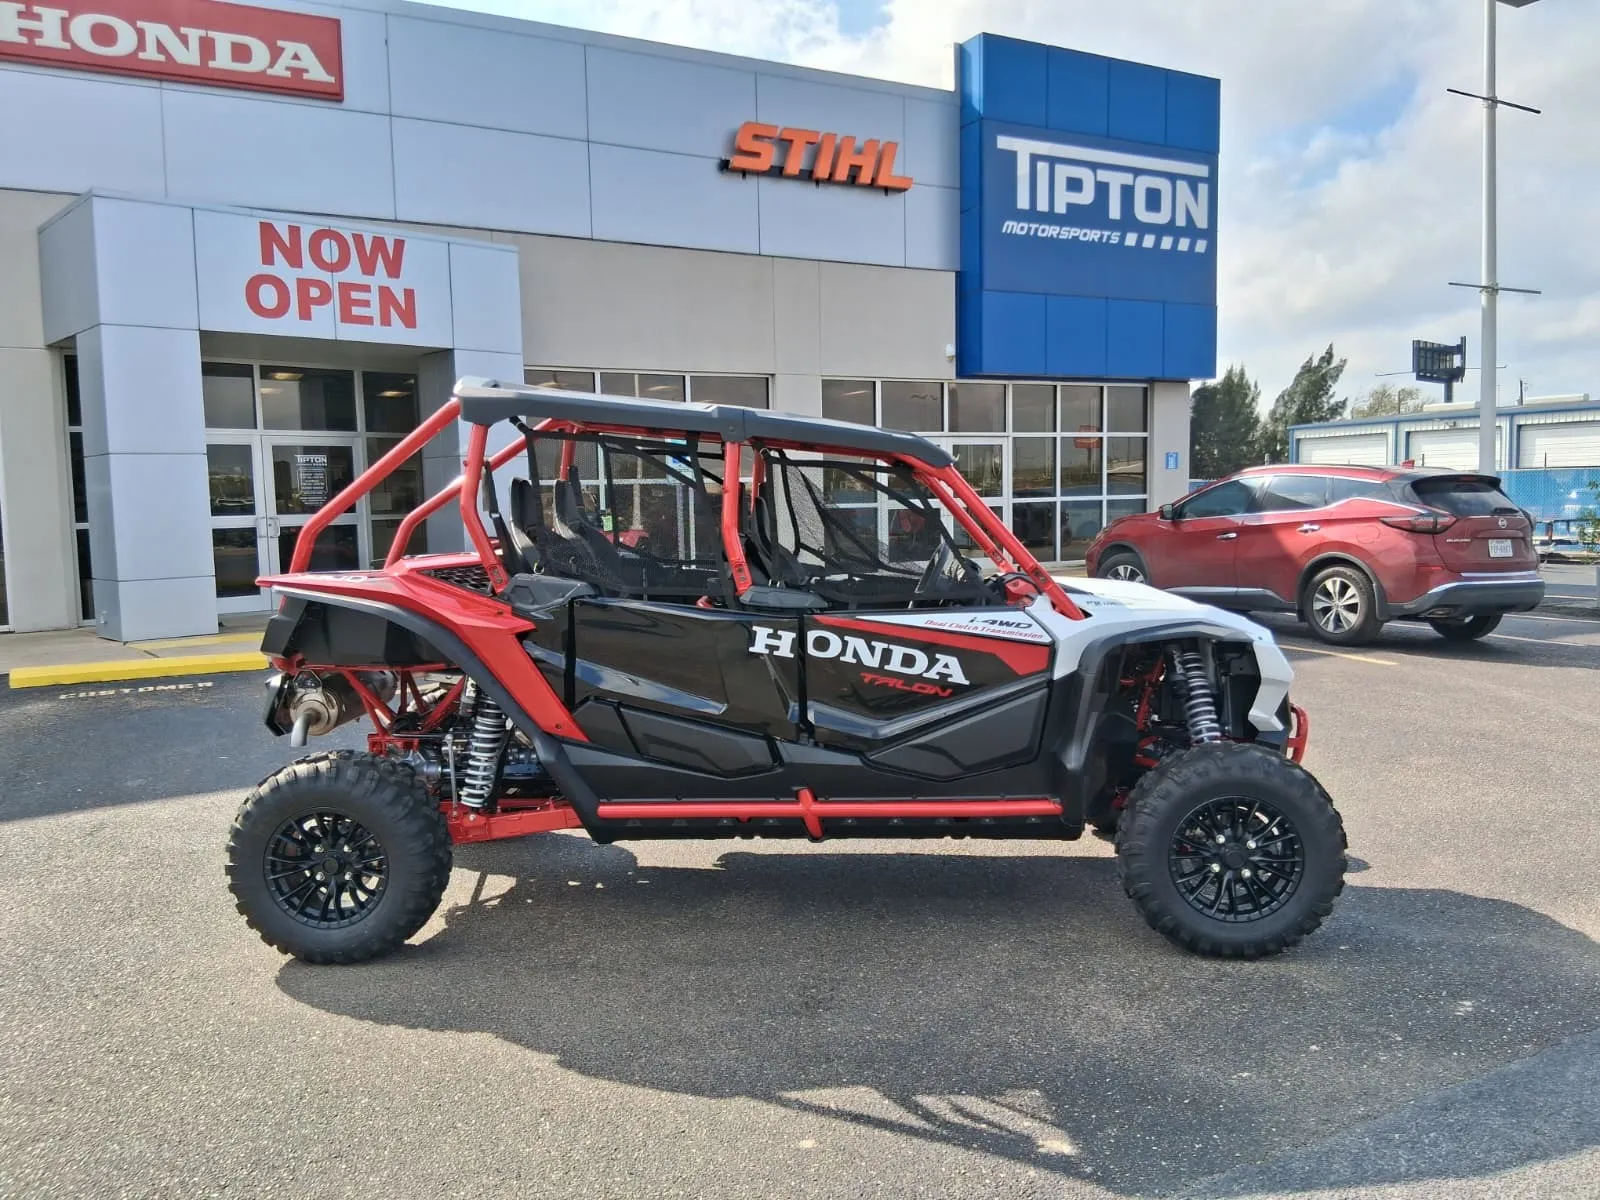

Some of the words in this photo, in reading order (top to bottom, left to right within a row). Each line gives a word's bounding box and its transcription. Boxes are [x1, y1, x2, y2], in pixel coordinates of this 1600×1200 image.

[0, 0, 335, 83] HONDA
[729, 120, 914, 190] STIHL
[997, 135, 1209, 229] TIPTON
[259, 221, 406, 279] NOW
[1002, 220, 1121, 244] MOTORSPORTS
[245, 273, 417, 329] OPEN
[748, 625, 970, 685] HONDA
[924, 619, 946, 627] Dual
[949, 622, 979, 631] Clutch
[980, 626, 1044, 639] Transmission
[859, 672, 953, 697] TALON
